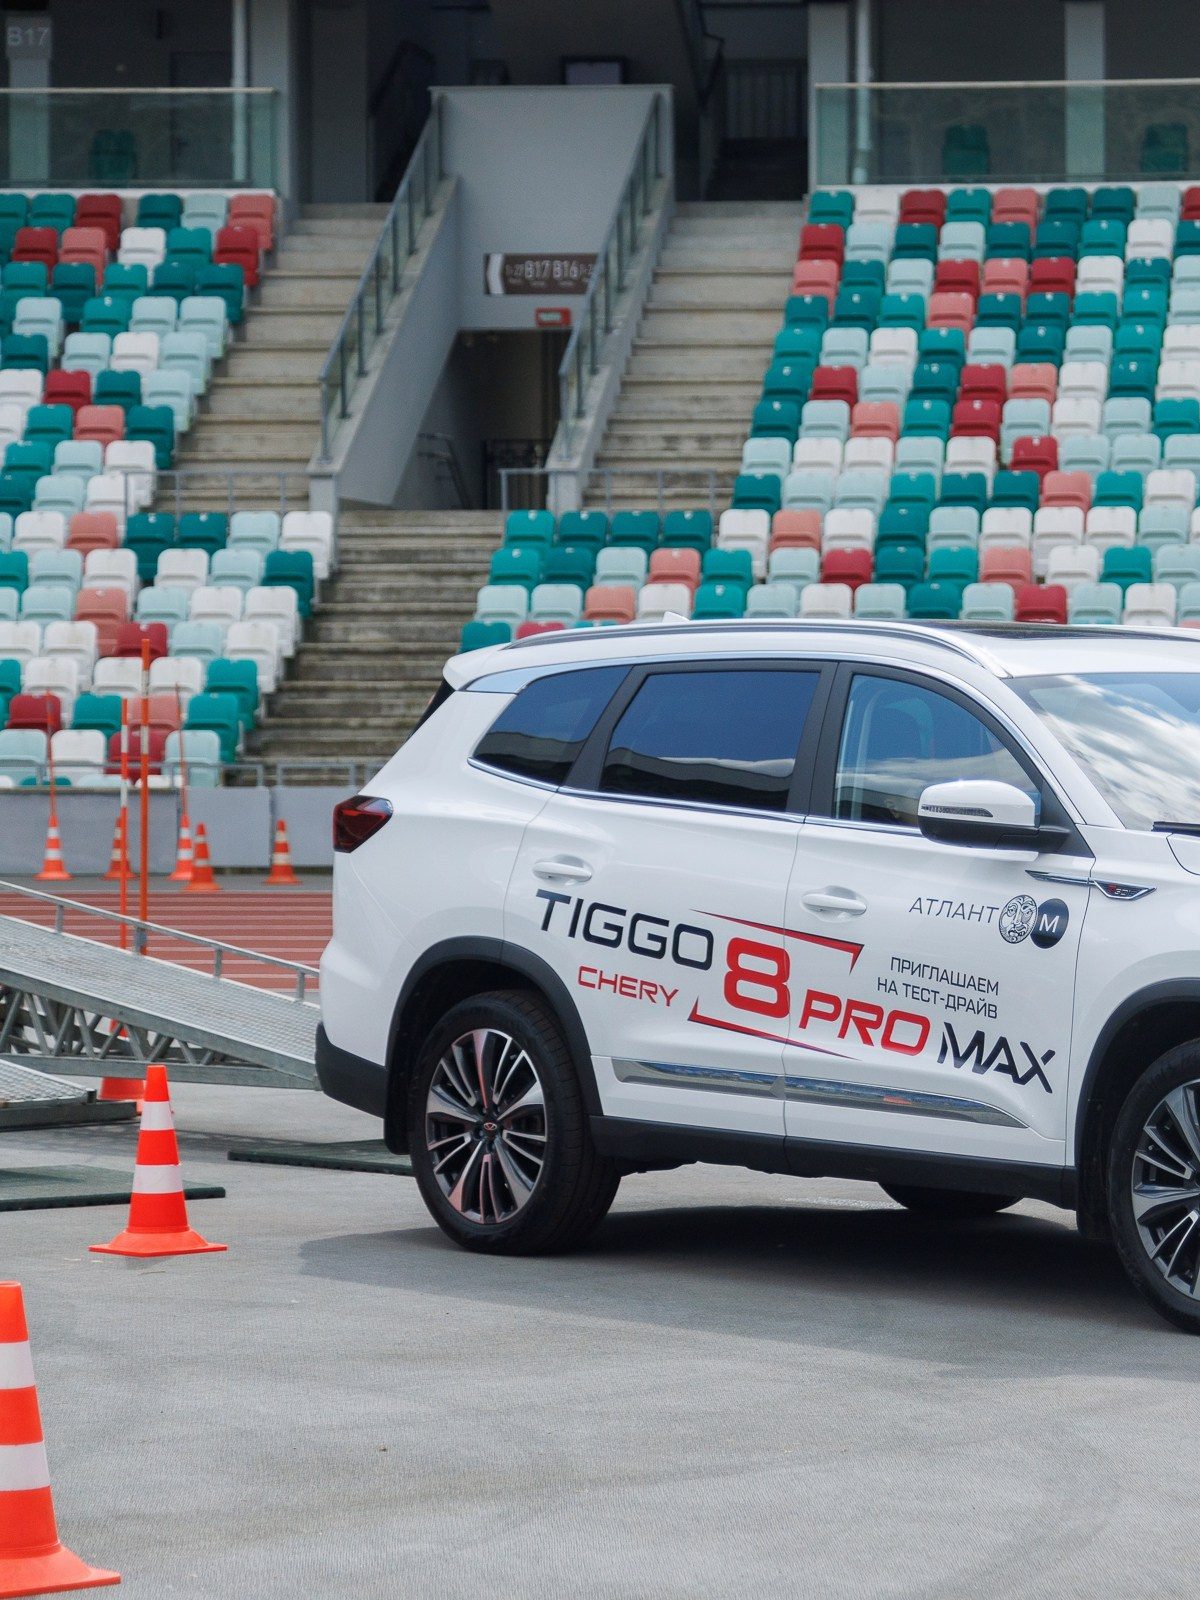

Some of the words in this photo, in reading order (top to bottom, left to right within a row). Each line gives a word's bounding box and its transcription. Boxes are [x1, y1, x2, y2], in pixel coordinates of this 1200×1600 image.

[7, 26, 49, 47] B17
[909, 897, 999, 924] АТЛАНТ
[536, 888, 714, 971] TIGGO
[723, 936, 791, 1020] 8
[798, 989, 931, 1057] PRO
[937, 1021, 1056, 1094] MAX
[577, 965, 680, 1007] CHERY
[890, 956, 1000, 996] ПРИГЛАШАЕМ
[877, 976, 899, 996] НА
[902, 982, 998, 1020] ТЕСТ-ДРАЙВ
